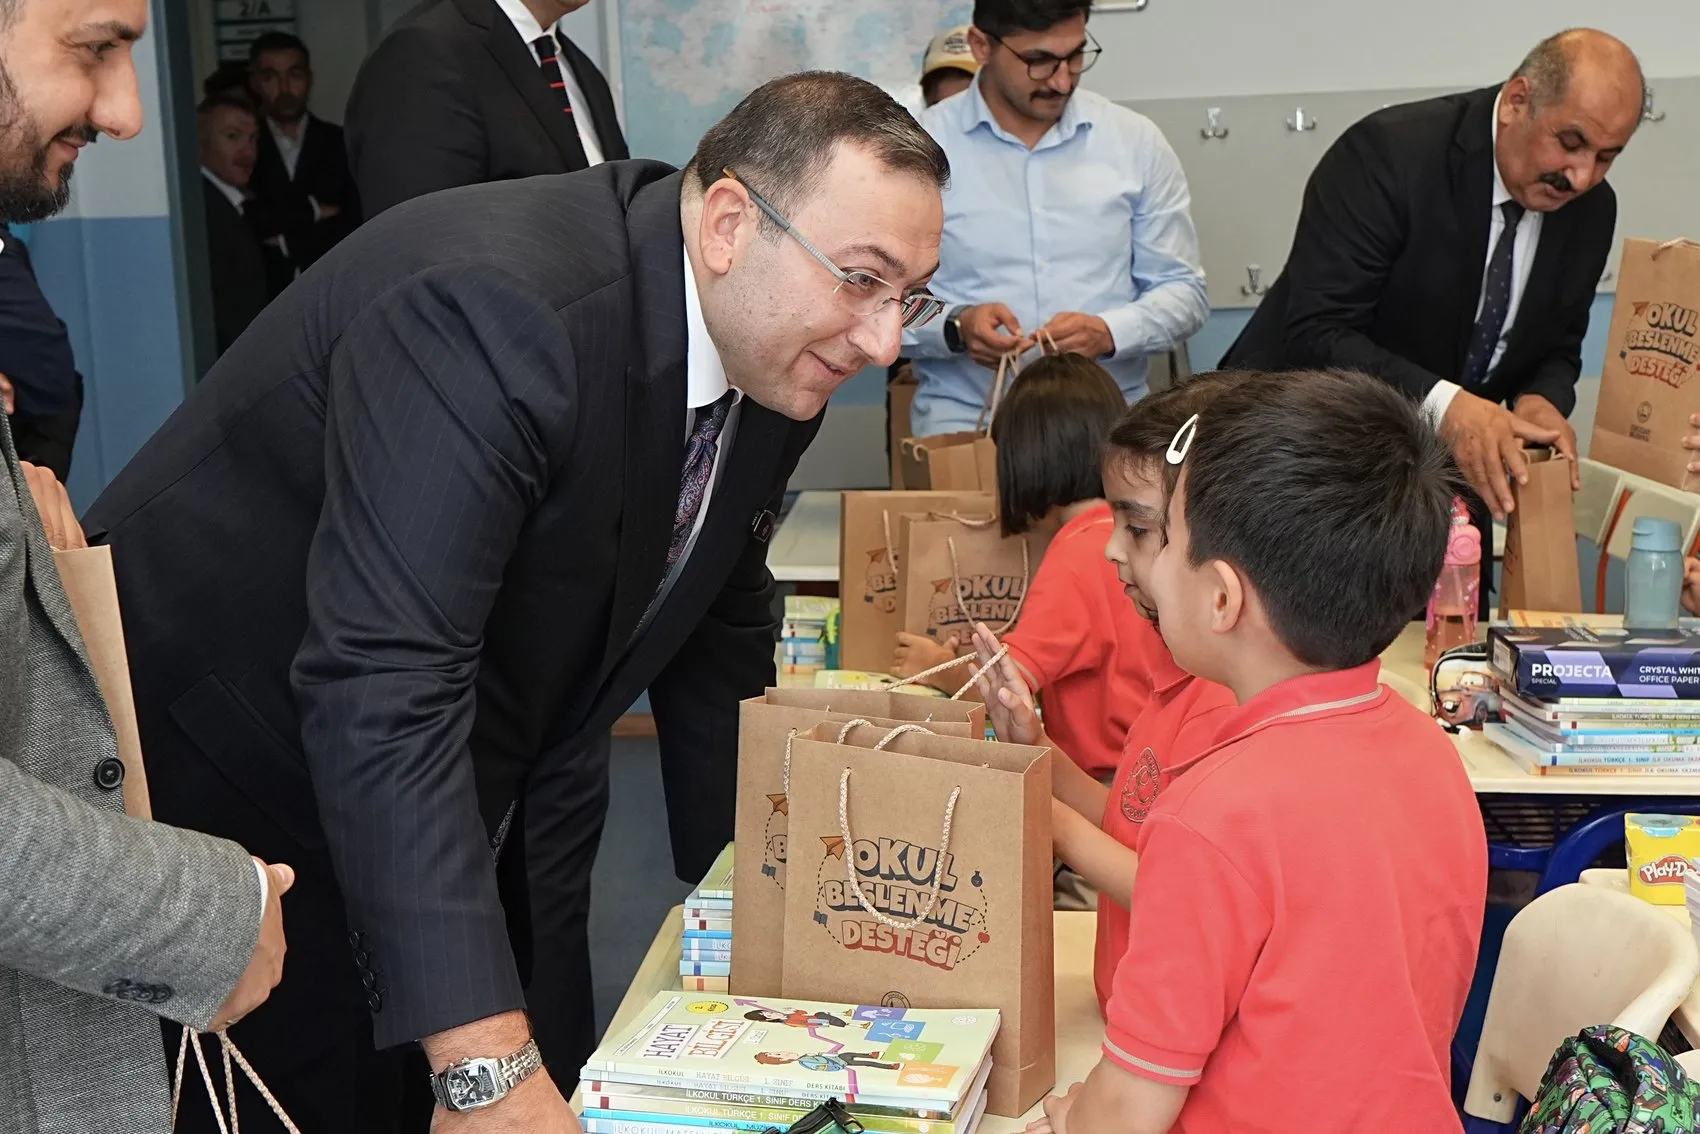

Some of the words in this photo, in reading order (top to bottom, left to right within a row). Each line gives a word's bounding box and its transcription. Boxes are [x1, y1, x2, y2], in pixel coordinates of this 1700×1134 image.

[1646, 302, 1699, 337] OKUL
[1627, 329, 1700, 365] BESLENME
[1630, 356, 1689, 389] DESTEĞİ
[935, 602, 1018, 625] BESLEN
[1531, 664, 1613, 678] PROJECTA
[1639, 665, 1677, 674] CRYSTAL
[1639, 675, 1670, 684] OFFICE
[1671, 676, 1700, 685] PAPER
[851, 837, 958, 892] OKUL
[1641, 861, 1695, 882] Play-D
[823, 880, 976, 934] BESLENME
[841, 919, 963, 971] DESTEĞİ
[643, 1024, 693, 1059] HAYAT
[687, 1019, 746, 1058] BİLGİSİ
[659, 1069, 684, 1077] İLKOKUL
[697, 1072, 720, 1081] HAYAT
[806, 1082, 824, 1091] DERS
[686, 1088, 720, 1100] İLKOKUL
[722, 1091, 755, 1104] TÜRKÇE
[757, 1096, 765, 1104] 1.
[765, 1097, 787, 1106] SINIF
[788, 1098, 812, 1108] DERS
[723, 1107, 757, 1120] TÜRKÇE
[768, 1112, 790, 1121] SINIF
